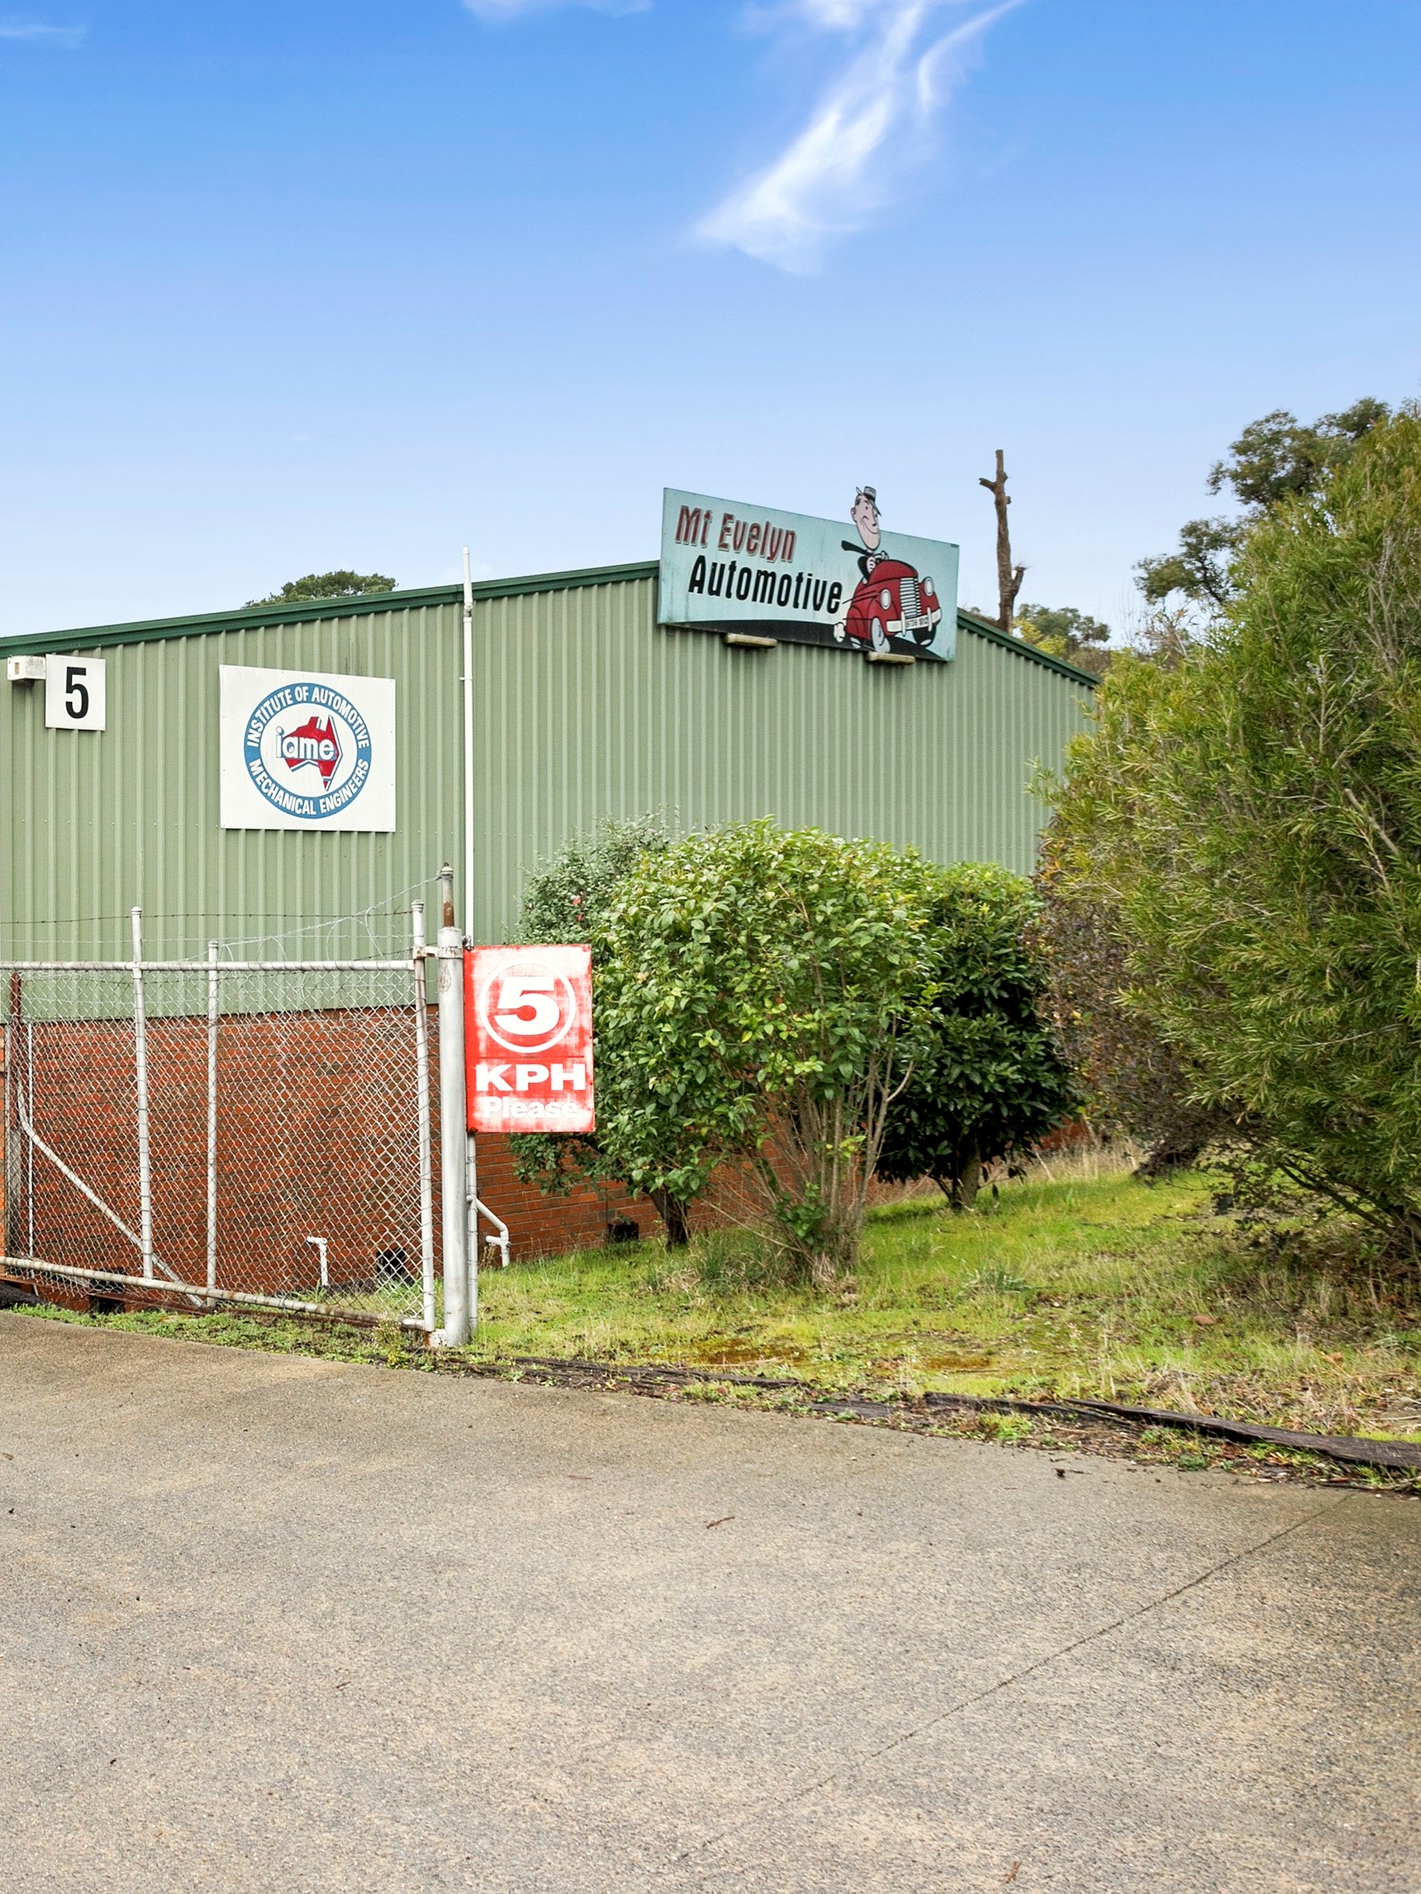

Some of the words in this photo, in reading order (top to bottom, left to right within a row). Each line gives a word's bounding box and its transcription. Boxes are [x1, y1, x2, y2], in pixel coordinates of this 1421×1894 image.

[674, 504, 712, 547] Mt
[717, 512, 797, 563] Evelyn
[688, 554, 843, 614] Automotive
[64, 666, 90, 719] 5
[246, 688, 293, 748] INSTITUTE
[294, 686, 309, 702] OF
[311, 686, 370, 749] AUTOMOTIVE
[276, 726, 336, 761] iame
[249, 758, 317, 815] MECHANICAL
[320, 758, 369, 814] ENGINEERS
[494, 976, 560, 1036] 5
[475, 1063, 586, 1091] KPH
[482, 1096, 580, 1119] Please
